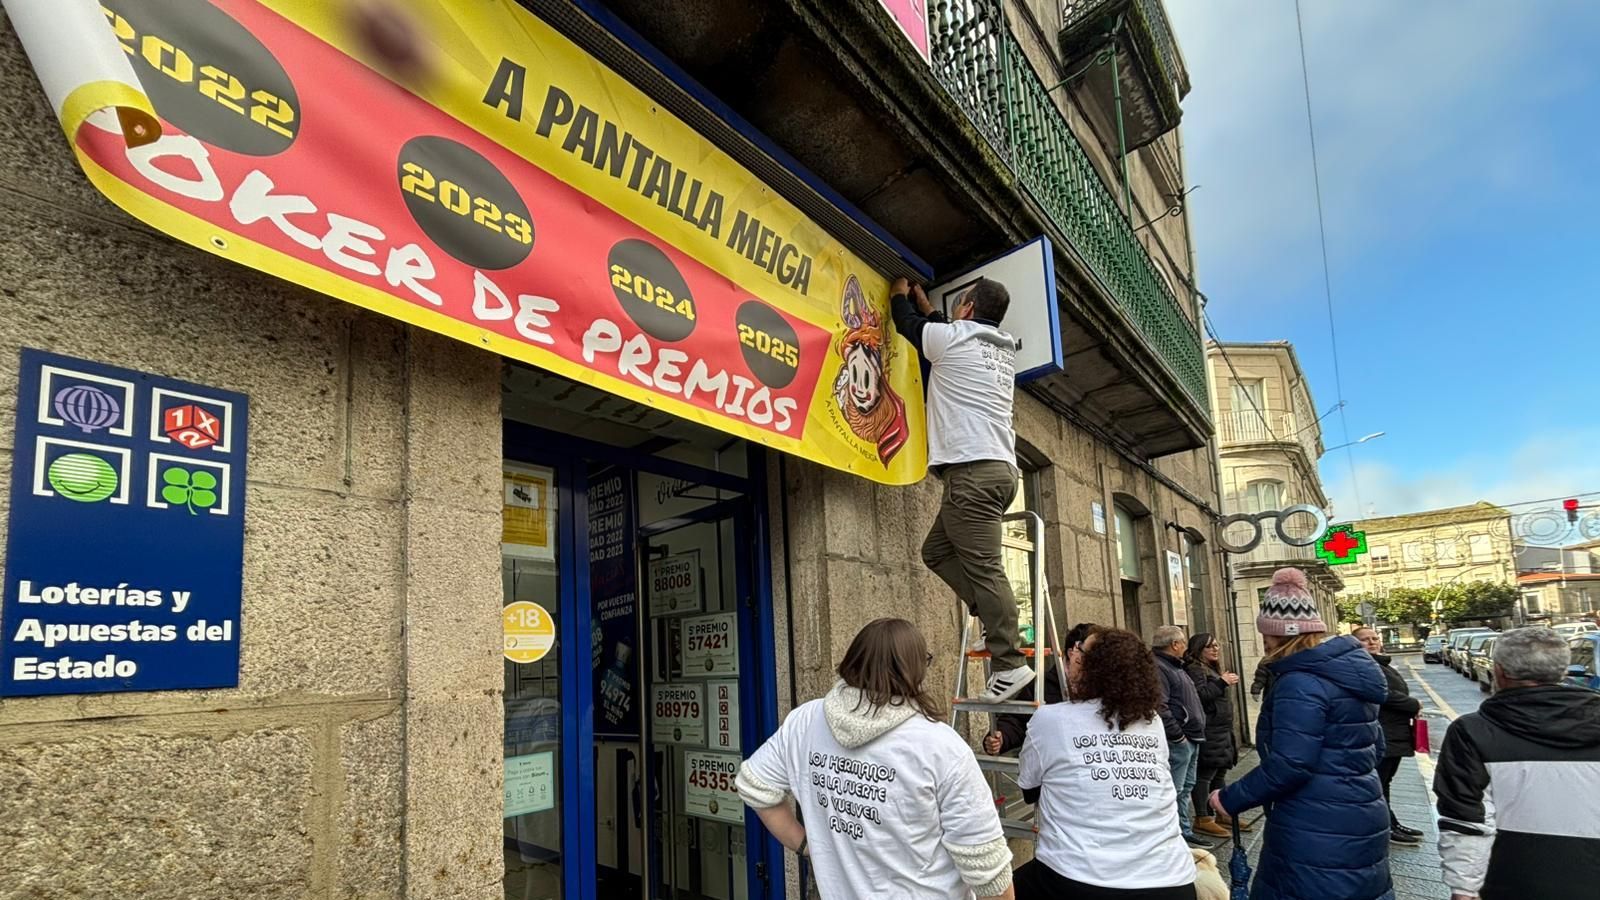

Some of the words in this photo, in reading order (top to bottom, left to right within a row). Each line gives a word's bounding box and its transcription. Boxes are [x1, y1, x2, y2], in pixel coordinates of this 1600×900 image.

[484, 57, 526, 122] A
[535, 85, 724, 239] PANTALLA
[726, 210, 812, 296] MEIGA
[401, 161, 533, 245] 2023
[610, 264, 695, 321] 2024
[472, 270, 560, 345] DE
[581, 318, 797, 431] PREMIOS
[737, 322, 799, 369] 2025
[825, 400, 831, 408] A
[828, 409, 858, 451] PANTALLA
[661, 561, 690, 577] PREMIO
[654, 572, 692, 592] 88008
[18, 580, 163, 607] Loterías
[171, 590, 191, 613] y
[609, 592, 635, 607] VUESTRA
[506, 608, 541, 628] +18
[600, 604, 633, 621] CONFIANZA
[14, 618, 177, 647] Apuestas
[186, 619, 232, 642] del
[695, 621, 729, 635] PREMIO
[688, 632, 729, 651] 57421
[13, 654, 137, 681] Estado
[600, 679, 631, 712] 94974
[664, 689, 697, 700] PREMIO
[655, 701, 700, 719] 88979
[1073, 734, 1097, 748] LOS
[1099, 733, 1159, 750] HERMANOS
[698, 759, 736, 773] PREMIO
[809, 751, 827, 768] LOS
[829, 755, 896, 783] HERMANOS
[1083, 751, 1102, 764] DE
[1103, 750, 1122, 764] LA
[1122, 750, 1157, 764] SUERTE
[1091, 768, 1110, 780] LO
[1112, 767, 1160, 783] VUELVEN
[812, 771, 825, 788] DE
[827, 776, 842, 795] LA
[843, 780, 887, 803] SUERTE
[1112, 785, 1124, 800] A
[1124, 785, 1149, 800] DAR
[817, 792, 828, 808] LO
[831, 796, 881, 824] VUELVEN
[830, 815, 842, 834] A
[841, 818, 863, 840] DAR
